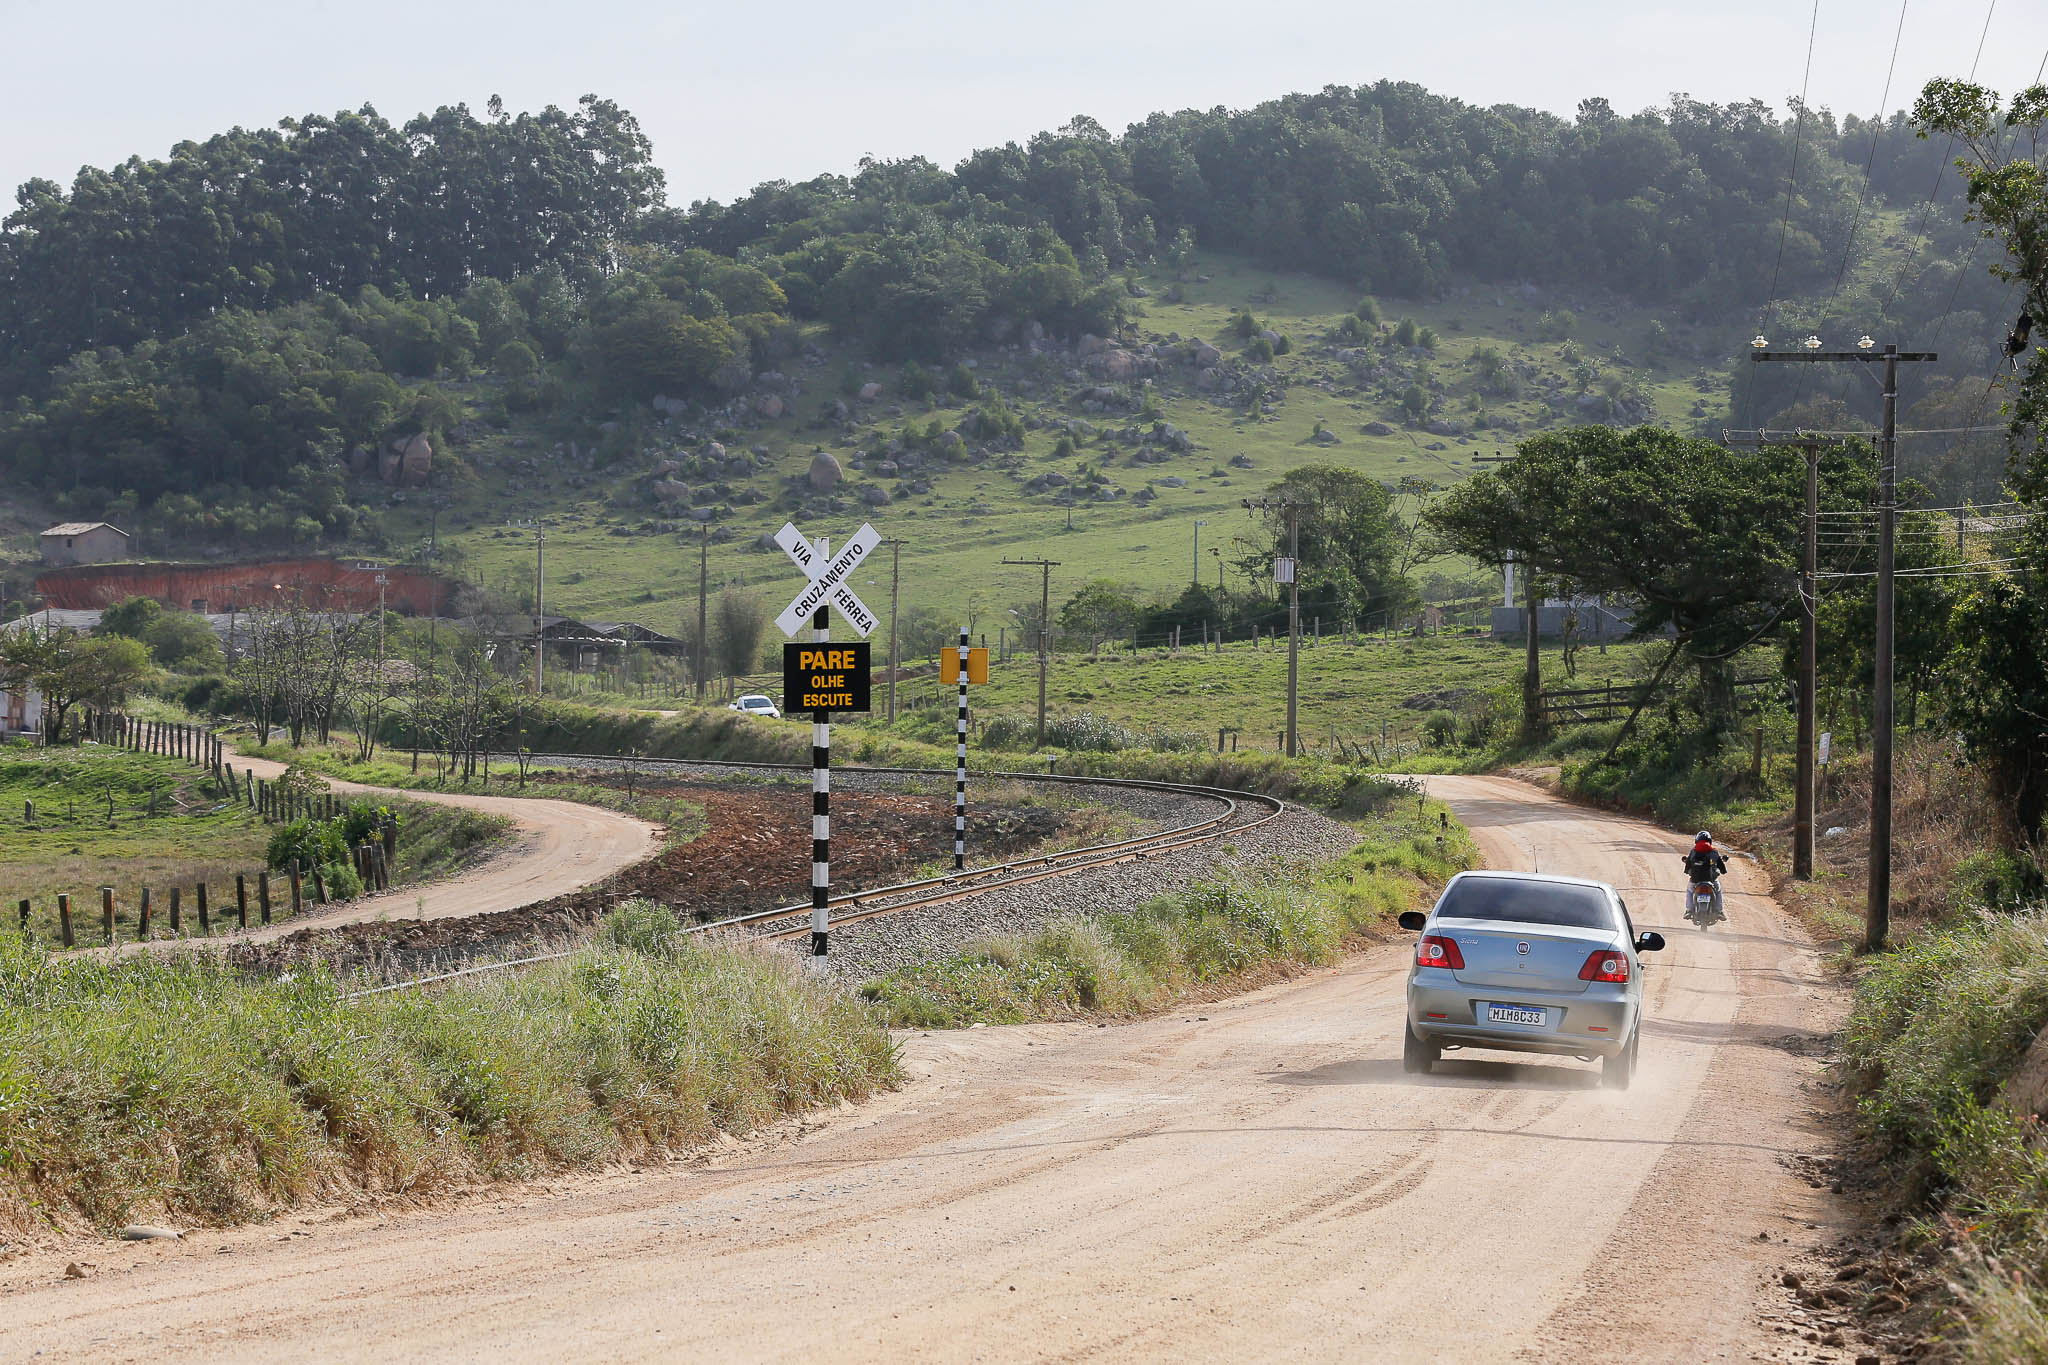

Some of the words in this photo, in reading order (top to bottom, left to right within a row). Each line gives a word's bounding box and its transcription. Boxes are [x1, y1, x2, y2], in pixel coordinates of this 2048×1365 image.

[792, 541, 812, 566] VIA
[795, 543, 863, 618] CRUZAMENTO
[833, 588, 873, 633] FÉRREA
[800, 650, 856, 670] PARE
[811, 675, 845, 689] OLHE
[803, 693, 853, 707] ESCUTE
[1493, 1008, 1540, 1024] MIM8C33
